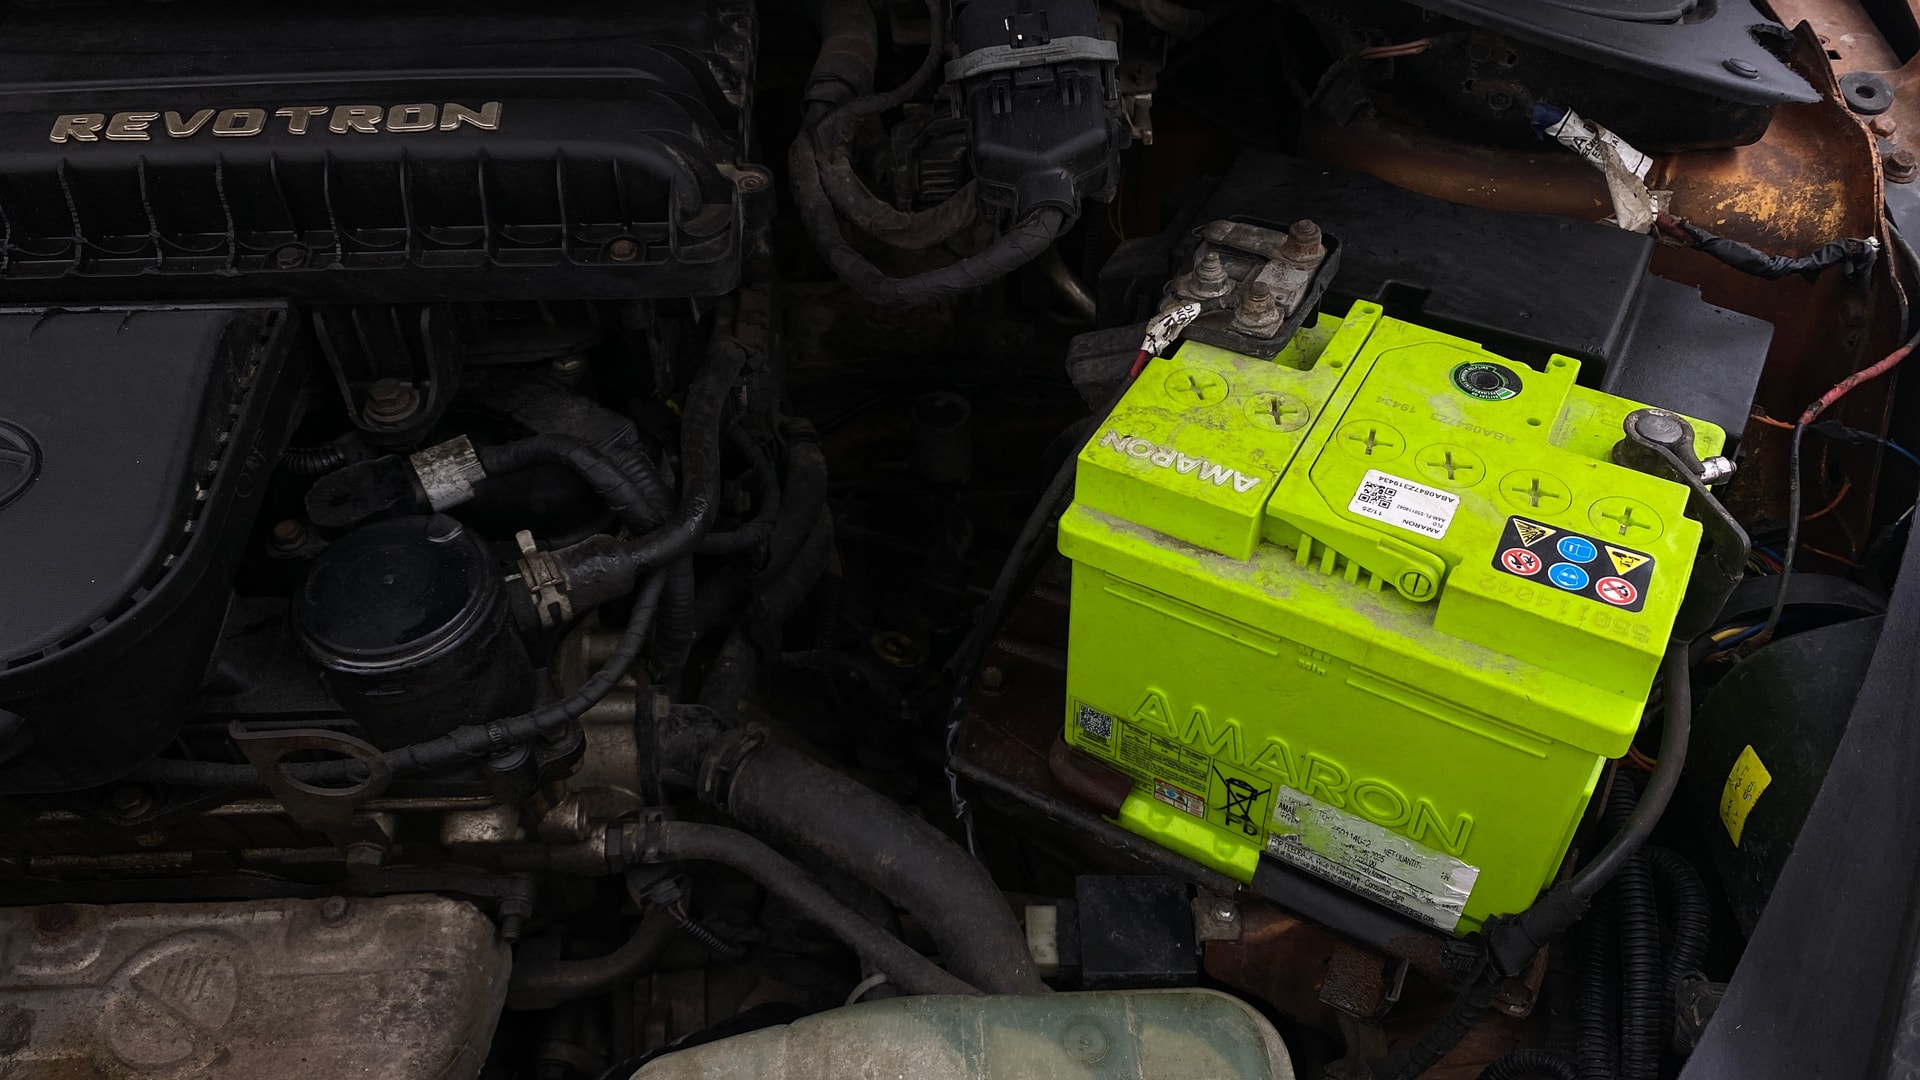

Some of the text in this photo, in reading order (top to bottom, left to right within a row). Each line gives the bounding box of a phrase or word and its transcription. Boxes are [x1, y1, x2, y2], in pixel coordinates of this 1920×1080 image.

[49, 101, 503, 144] REVOTRON
[1100, 430, 1261, 493] AMARON
[1379, 476, 1455, 503] ABA0847Z319434
[1362, 506, 1382, 516] 11/25
[1402, 519, 1440, 534] AMARON
[1127, 687, 1474, 856] AMARON
[1364, 879, 1391, 897] Consumer
[1391, 890, 1405, 902] Care
